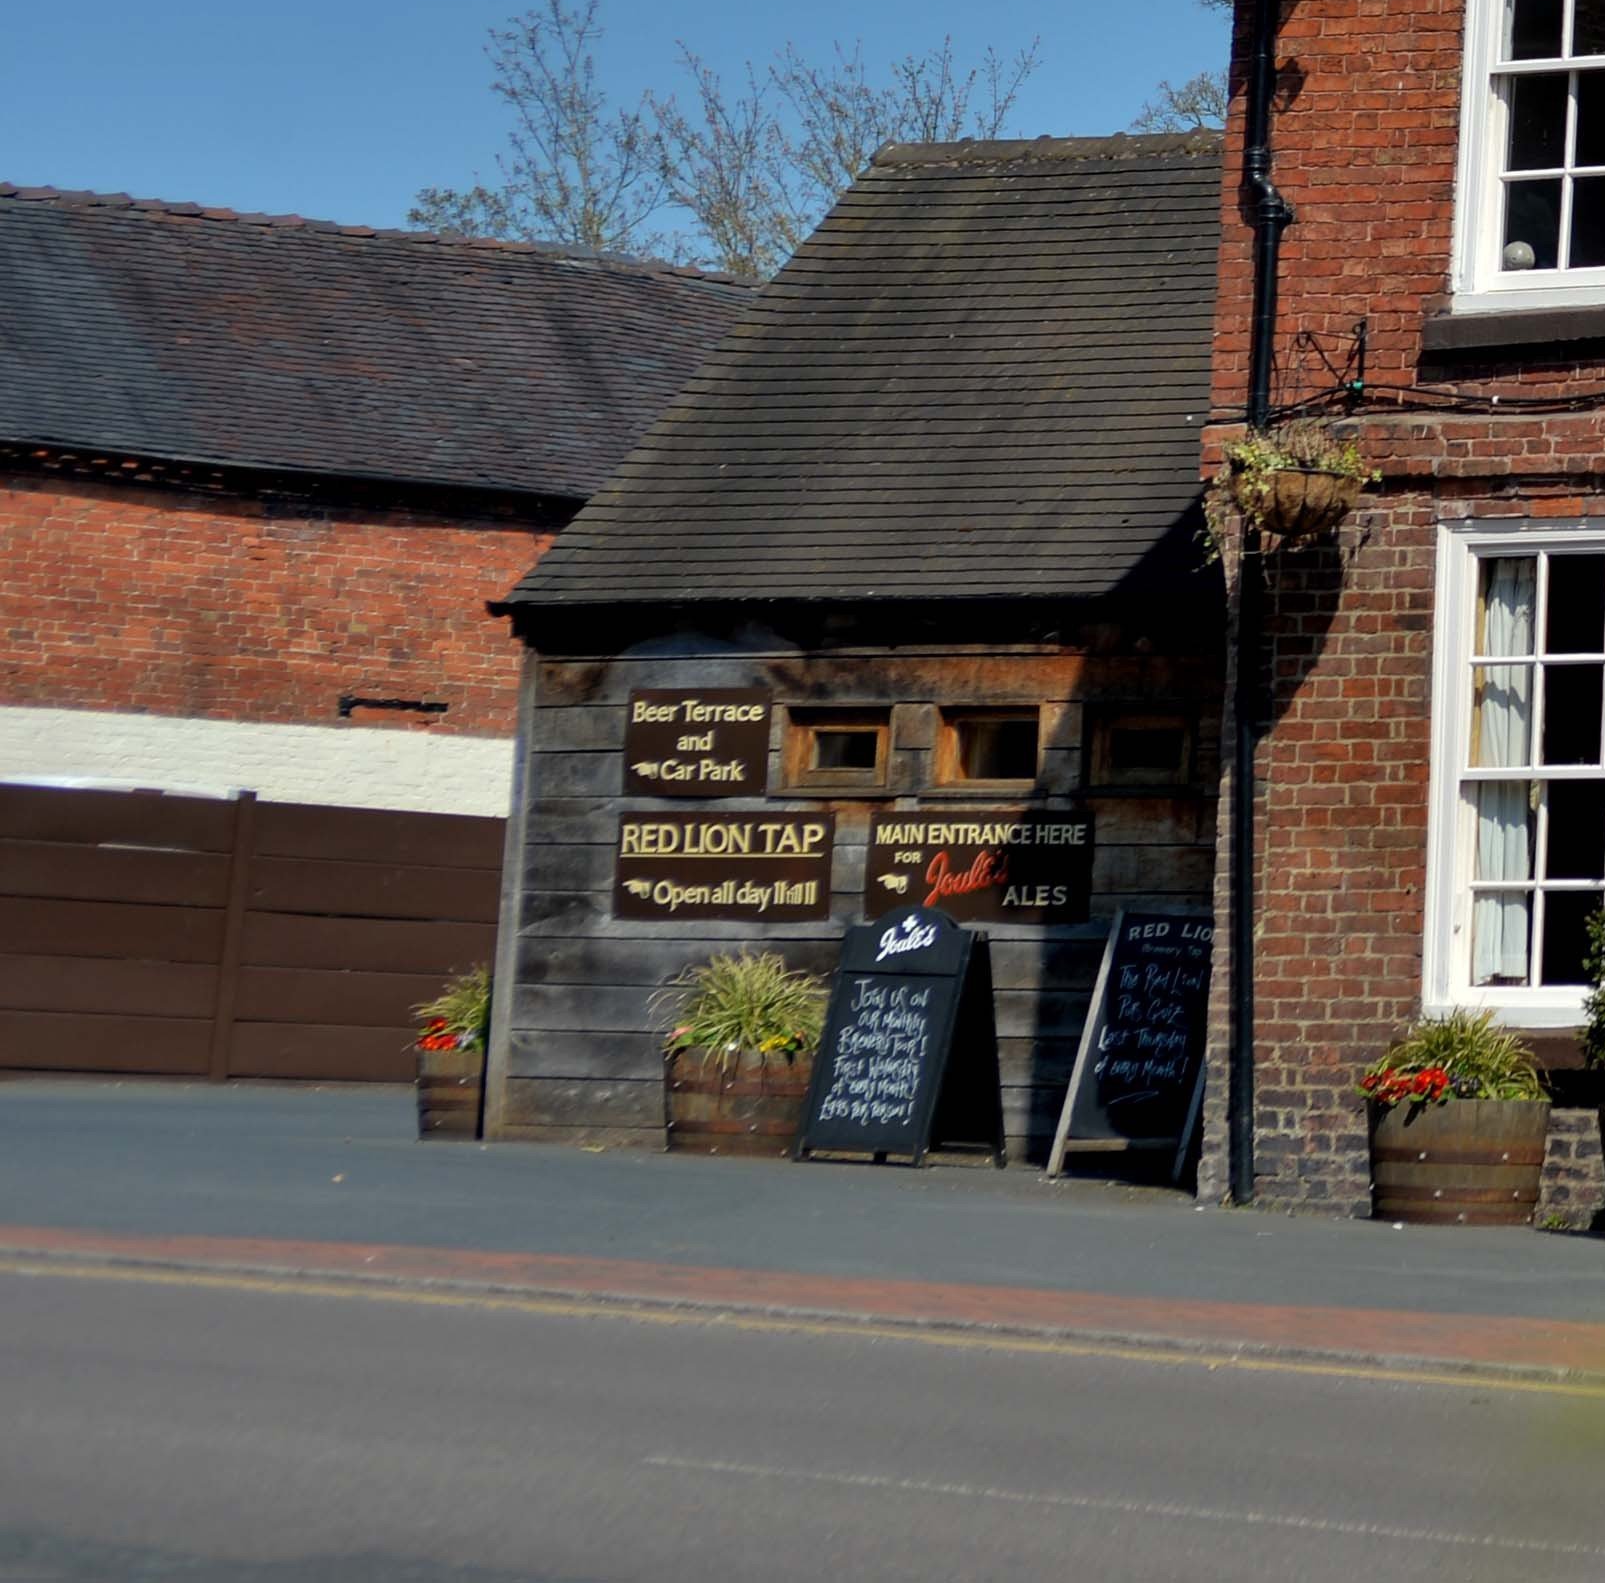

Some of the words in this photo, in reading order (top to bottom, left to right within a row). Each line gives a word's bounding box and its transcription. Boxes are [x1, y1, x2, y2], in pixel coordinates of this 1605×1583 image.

[632, 701, 679, 723] Beer
[681, 700, 766, 723] Terrace
[676, 730, 715, 751] and
[660, 759, 697, 781] Car
[699, 759, 745, 782] Park
[621, 824, 679, 854] RED
[683, 824, 752, 854] LION
[758, 824, 825, 854] TAP
[875, 824, 925, 845] MAIN
[927, 824, 1032, 845] ENTRANCE
[1035, 824, 1087, 845] HERE
[894, 851, 923, 864] FOR
[653, 880, 710, 913] Open
[711, 880, 736, 905] all
[736, 880, 772, 913] day
[1002, 885, 1068, 906] ALES
[1128, 922, 1171, 942] RED
[1181, 923, 1214, 944] LIO
